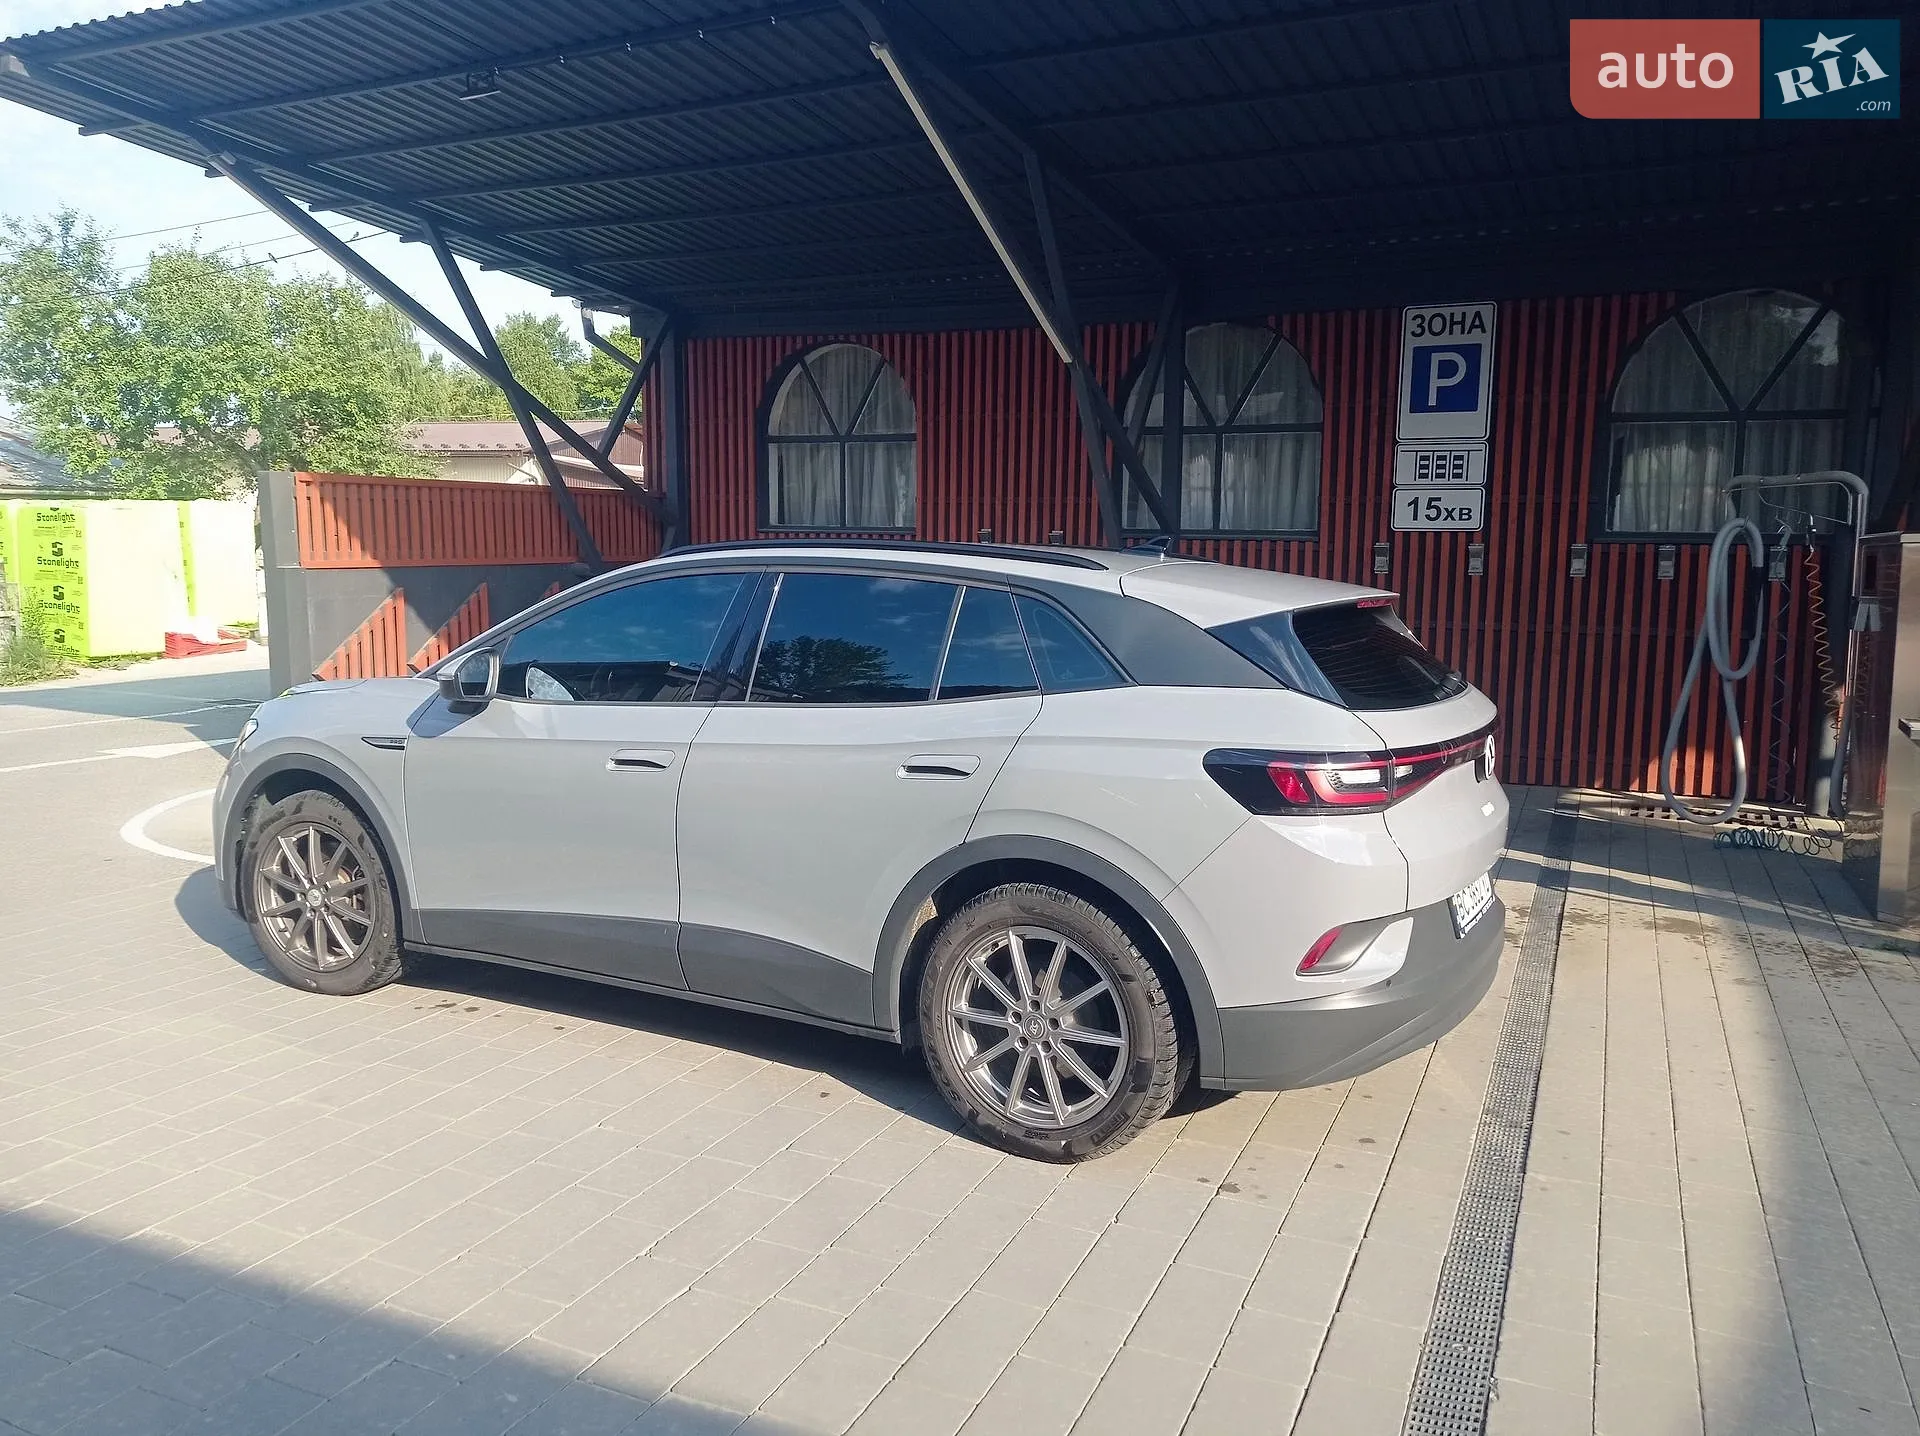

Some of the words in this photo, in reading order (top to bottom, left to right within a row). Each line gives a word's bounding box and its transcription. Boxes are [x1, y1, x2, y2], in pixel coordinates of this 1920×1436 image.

[1410, 310, 1487, 338] ЗОНА
[1427, 351, 1467, 407] P
[36, 512, 76, 524] Stonelight
[37, 556, 80, 568] Stonelight
